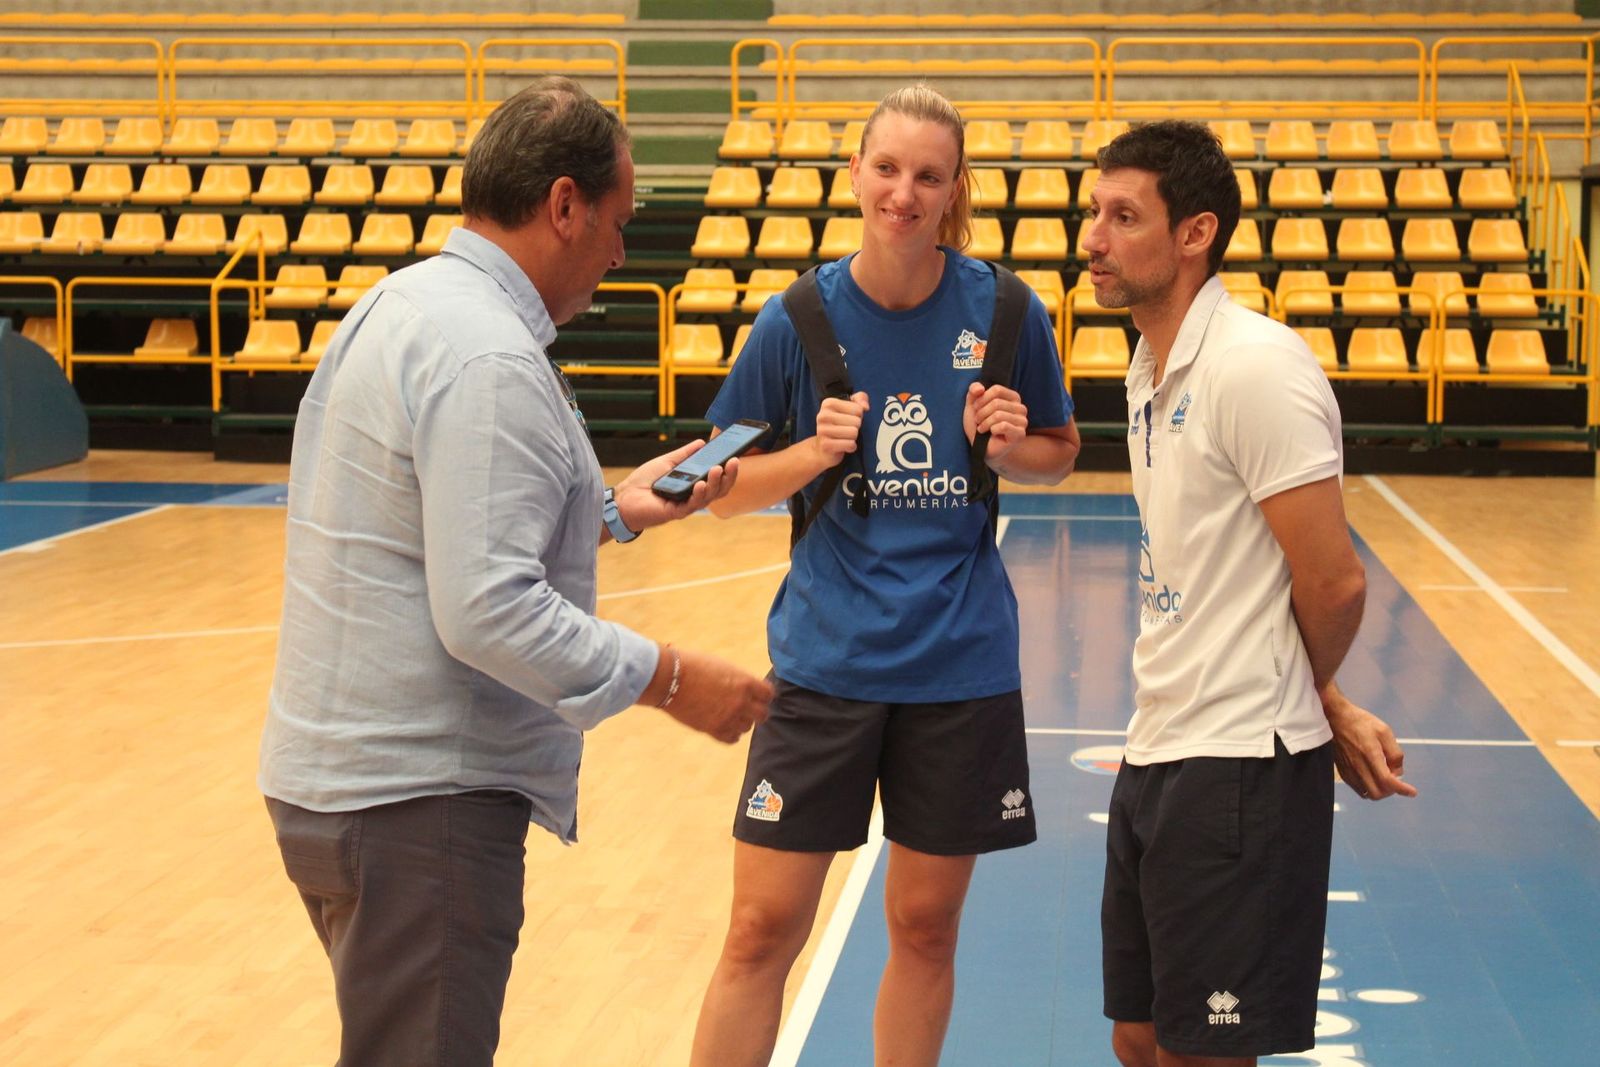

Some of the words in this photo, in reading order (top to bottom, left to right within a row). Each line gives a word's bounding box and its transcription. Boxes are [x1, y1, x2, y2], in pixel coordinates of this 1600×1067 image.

[847, 496, 969, 509] PRFUMERÍAS
[1002, 807, 1026, 820] errea
[1208, 1013, 1241, 1025] errea
